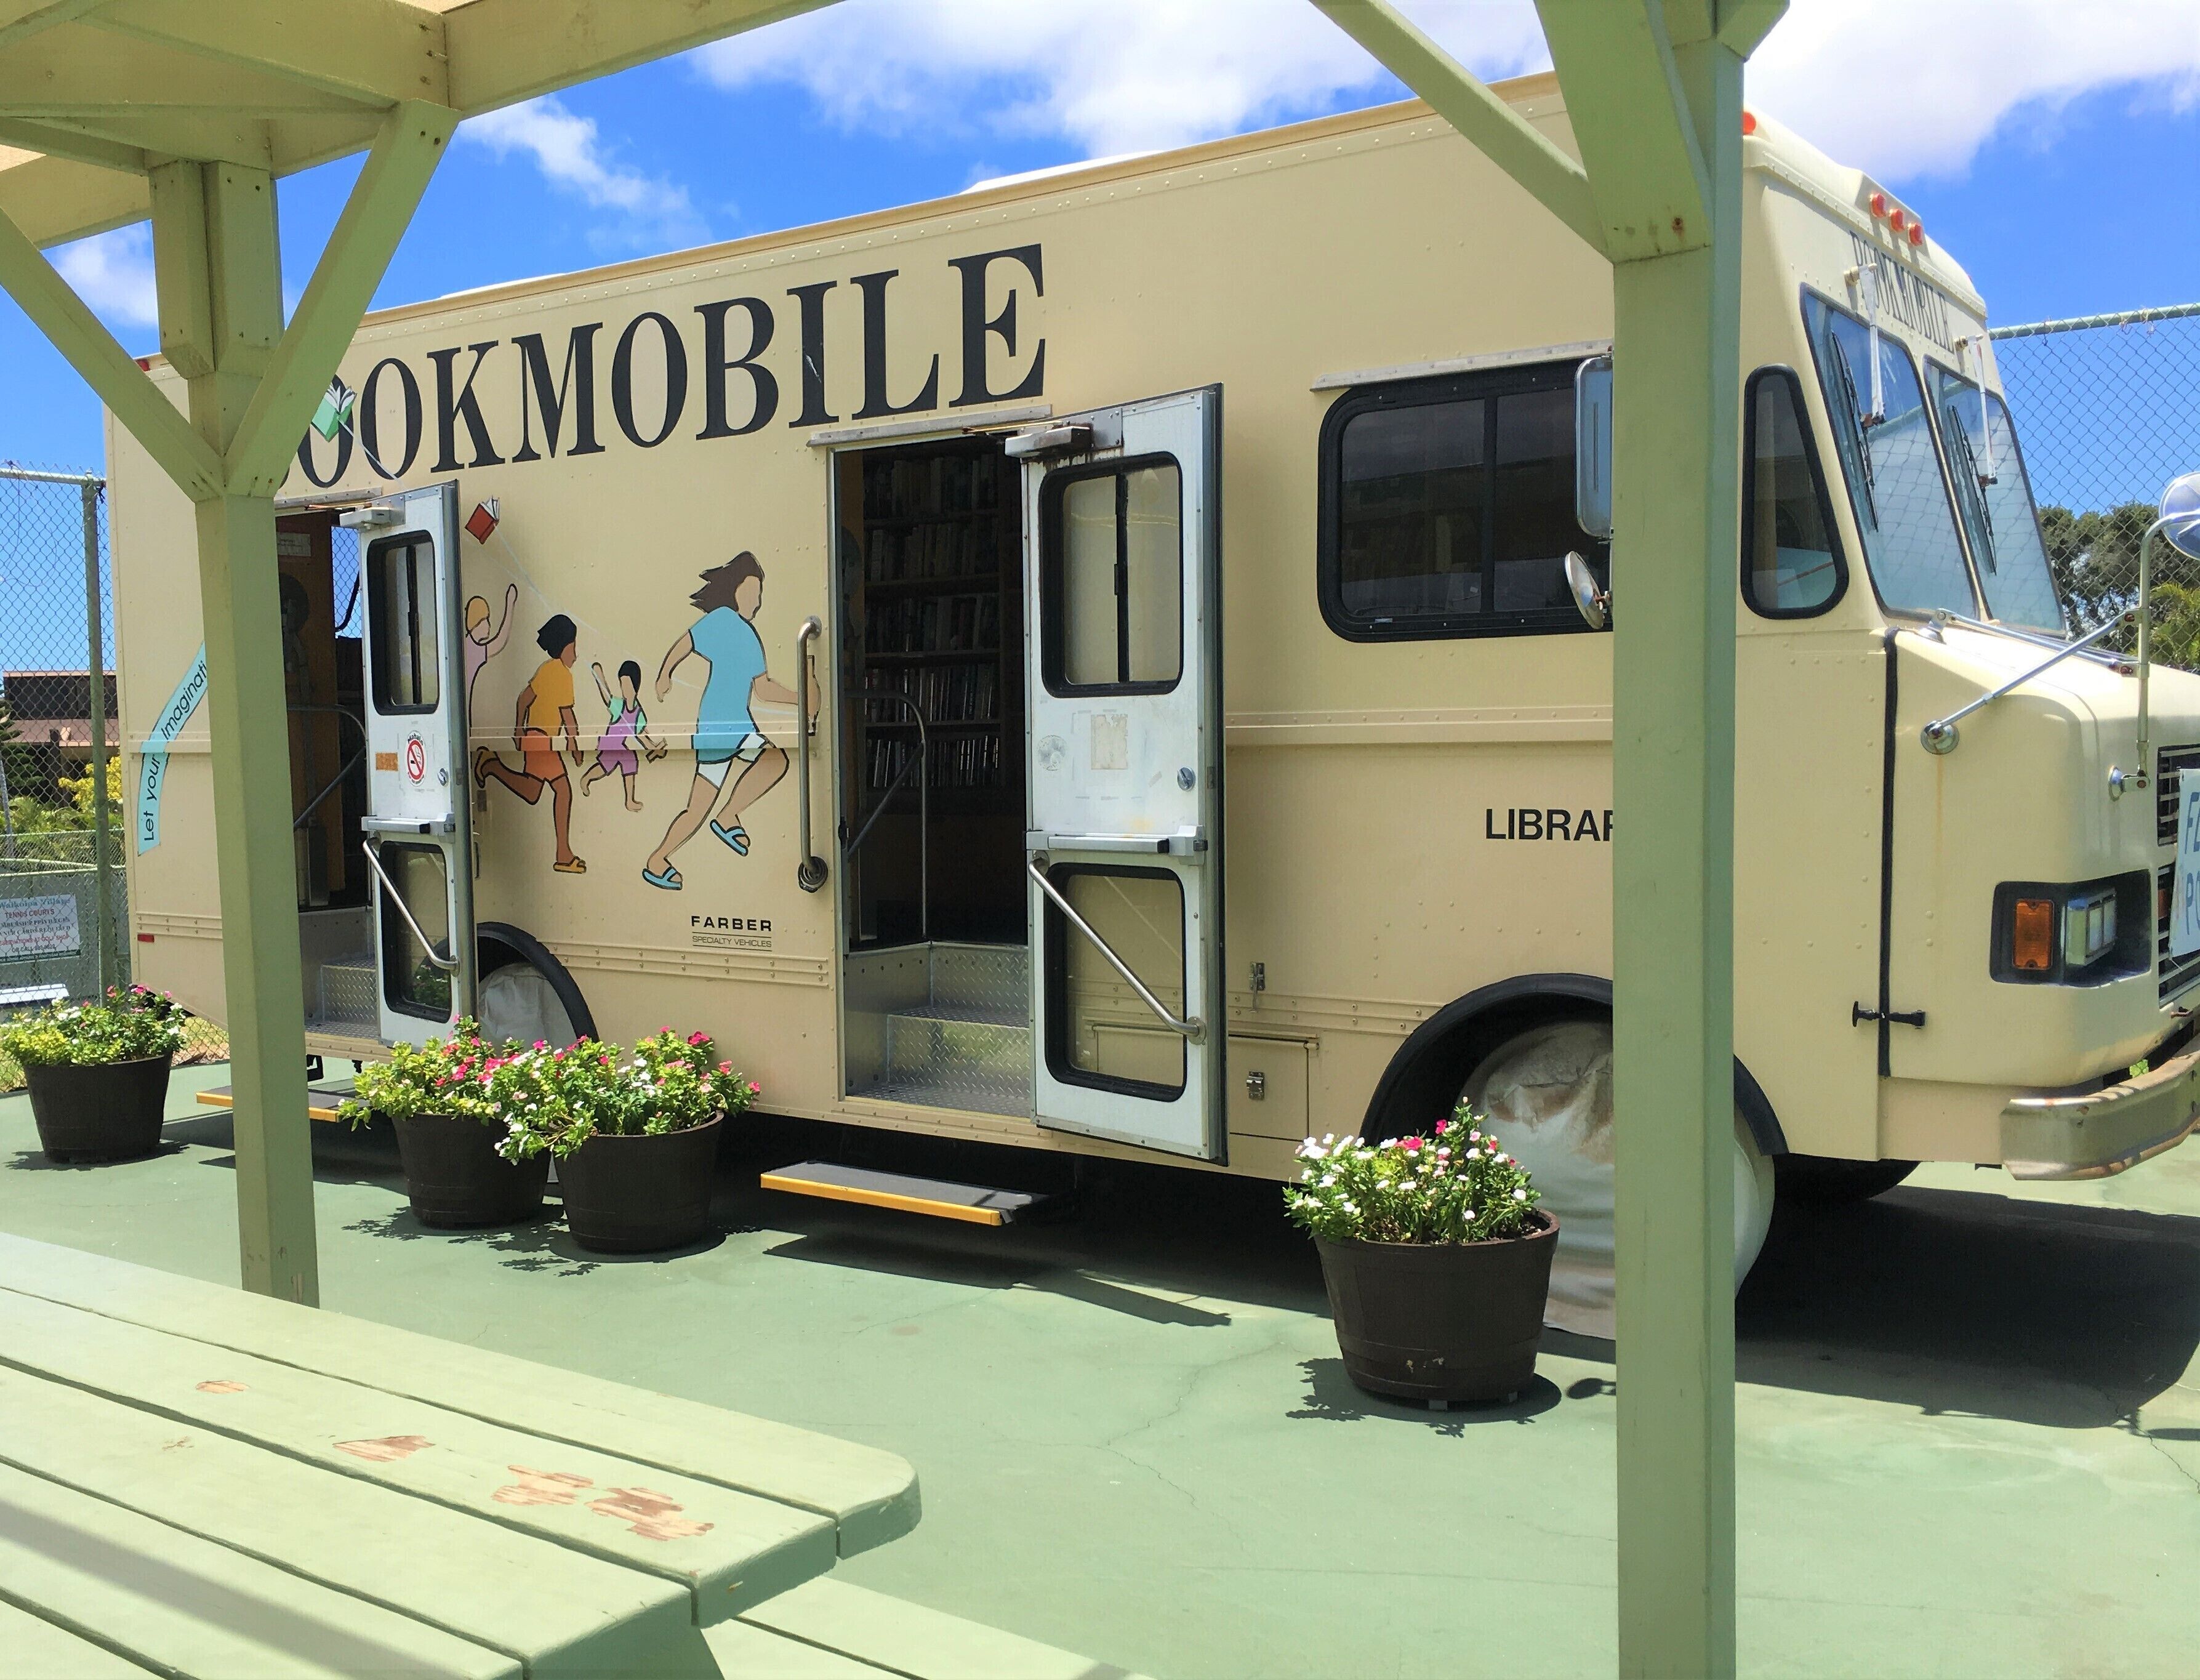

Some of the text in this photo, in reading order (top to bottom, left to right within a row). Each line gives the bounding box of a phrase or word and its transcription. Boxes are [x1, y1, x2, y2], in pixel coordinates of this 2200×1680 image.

[278, 244, 1045, 488] OOKMOBILE
[147, 754, 161, 801] your
[144, 810, 154, 841] Let
[40, 898, 70, 906] Village
[29, 909, 55, 917] COURTS
[691, 915, 772, 932] FARBER
[693, 935, 772, 948] SPECIALTY VEHICLES
